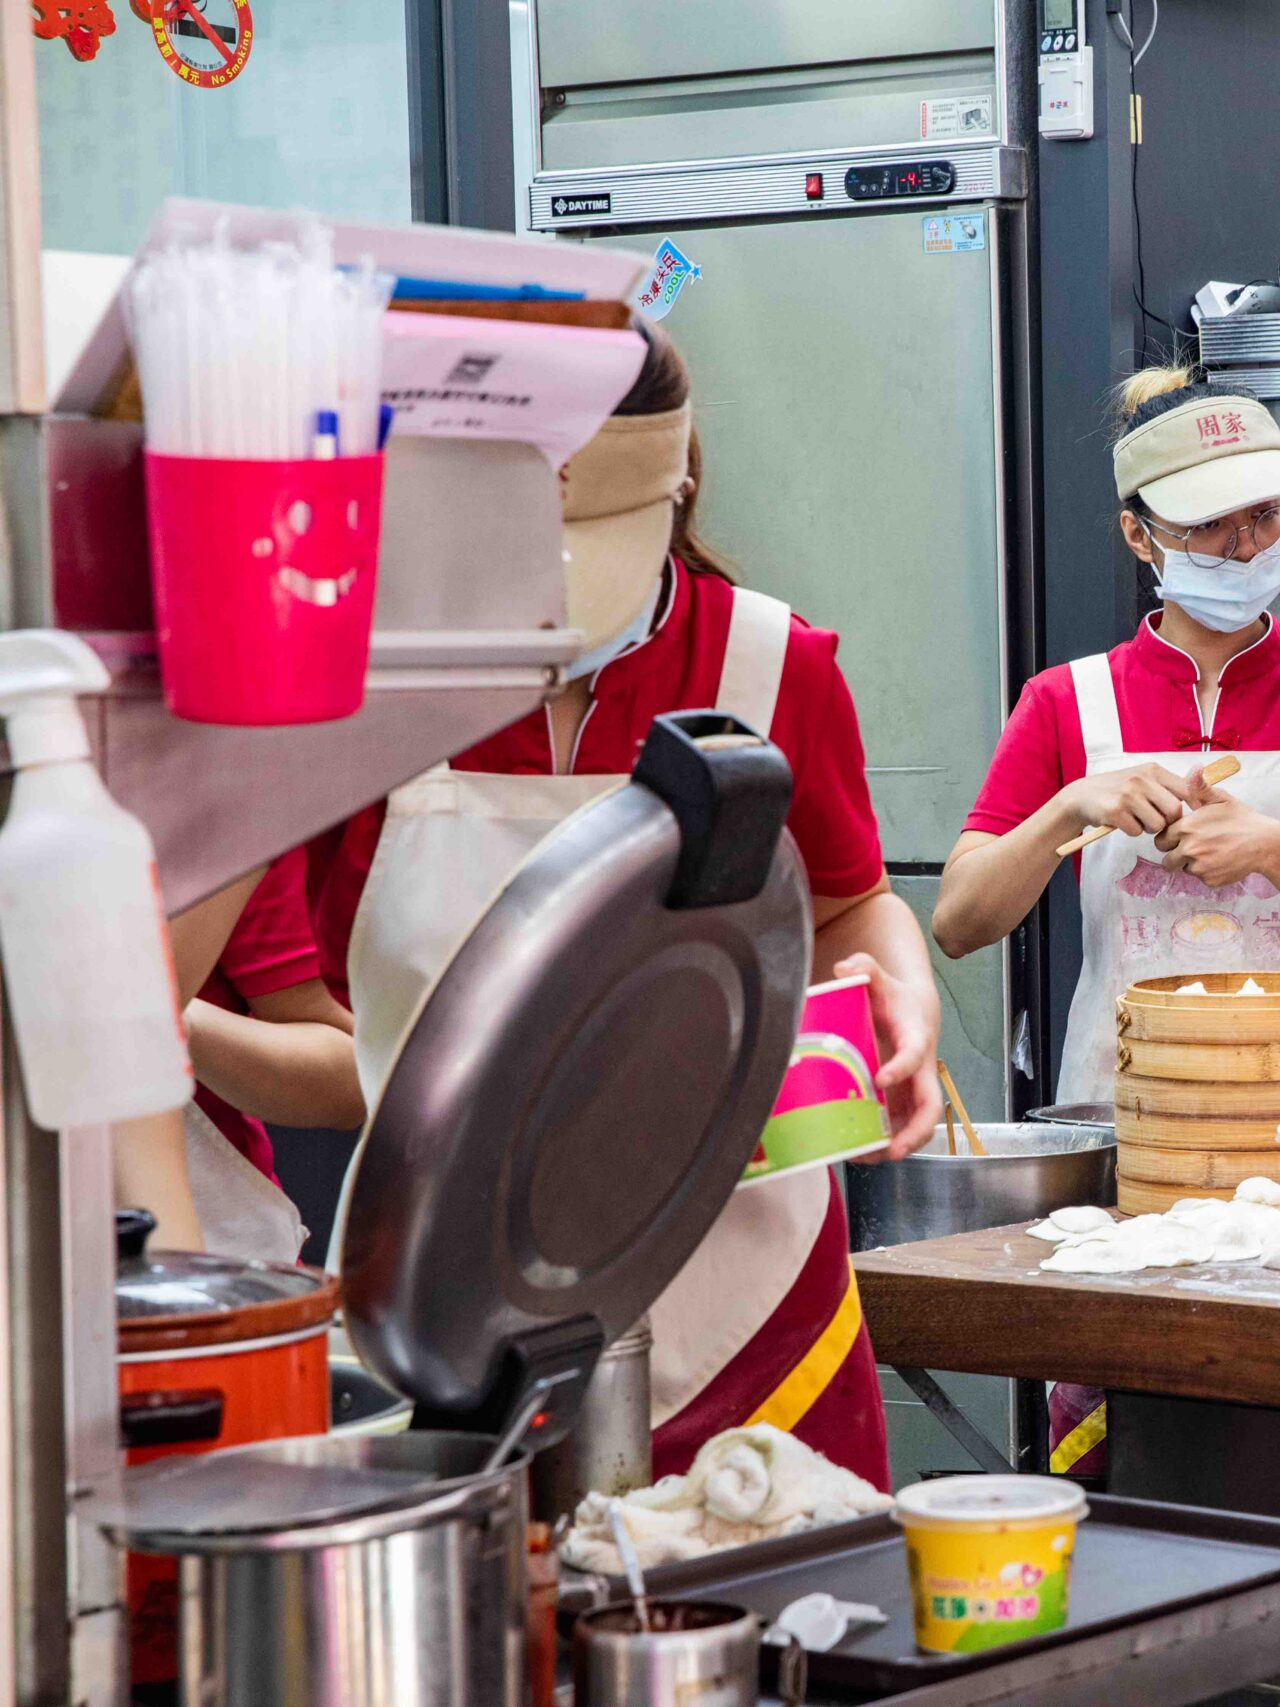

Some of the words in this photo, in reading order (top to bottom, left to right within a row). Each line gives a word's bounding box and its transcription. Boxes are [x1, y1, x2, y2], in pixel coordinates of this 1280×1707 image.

[211, 75, 226, 85] No
[226, 30, 252, 78] Smoking
[568, 199, 609, 211] DAYTIME
[639, 250, 682, 307] 冷凍尖兵
[664, 270, 685, 304] COOL
[1196, 412, 1246, 441] 周家
